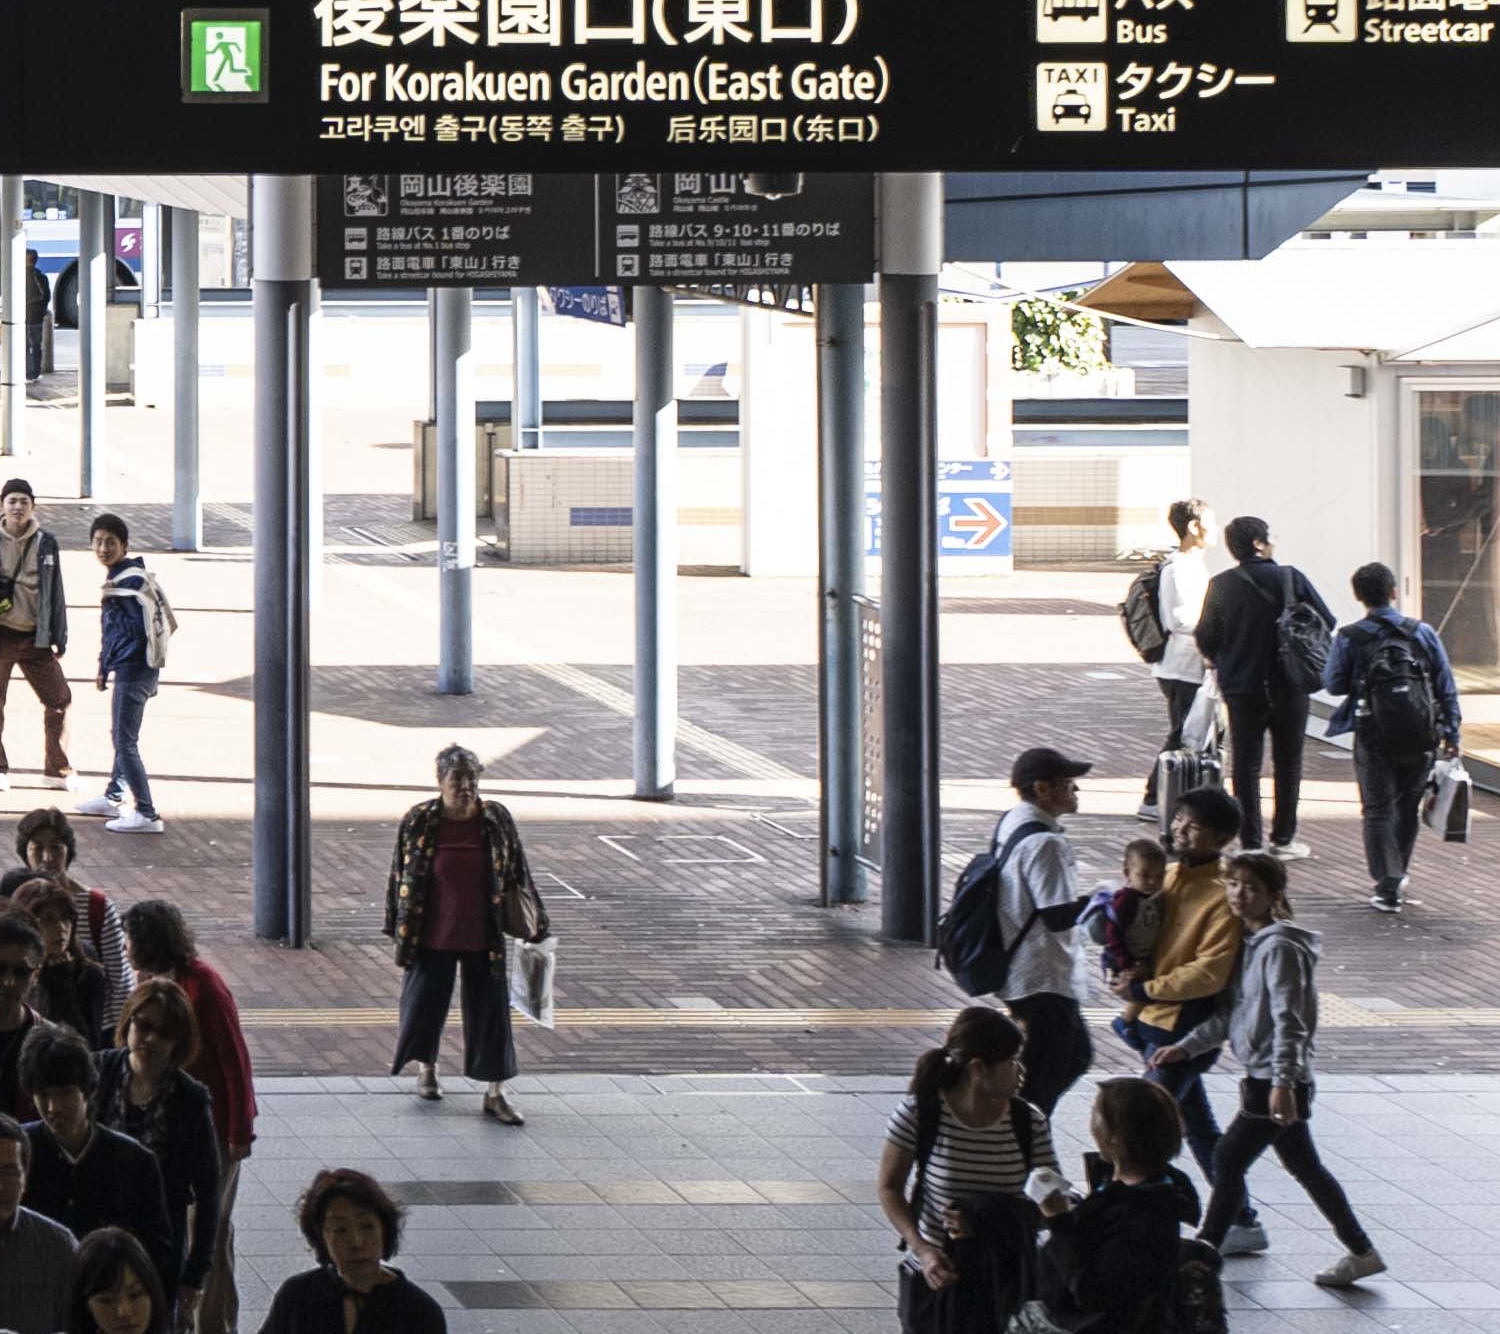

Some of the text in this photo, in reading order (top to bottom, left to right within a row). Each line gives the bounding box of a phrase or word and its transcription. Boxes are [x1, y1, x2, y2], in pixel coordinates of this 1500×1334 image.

[1116, 19, 1167, 44] Bus
[1365, 19, 1495, 44] Streetcar
[320, 63, 377, 103] For
[384, 63, 552, 103] Korakuen
[790, 57, 889, 107] Gate)
[1044, 68, 1099, 84] TAXI
[1116, 63, 1276, 101] タクシー
[319, 116, 426, 143] 고라쿠엔
[562, 114, 625, 144] 출구)
[667, 115, 880, 144] 后乐园口(东口)
[1116, 107, 1176, 133] Taxi
[400, 174, 534, 197] 岡山後楽園
[376, 226, 510, 241] 路線バス 1番のりば
[649, 224, 708, 238] 路線バス
